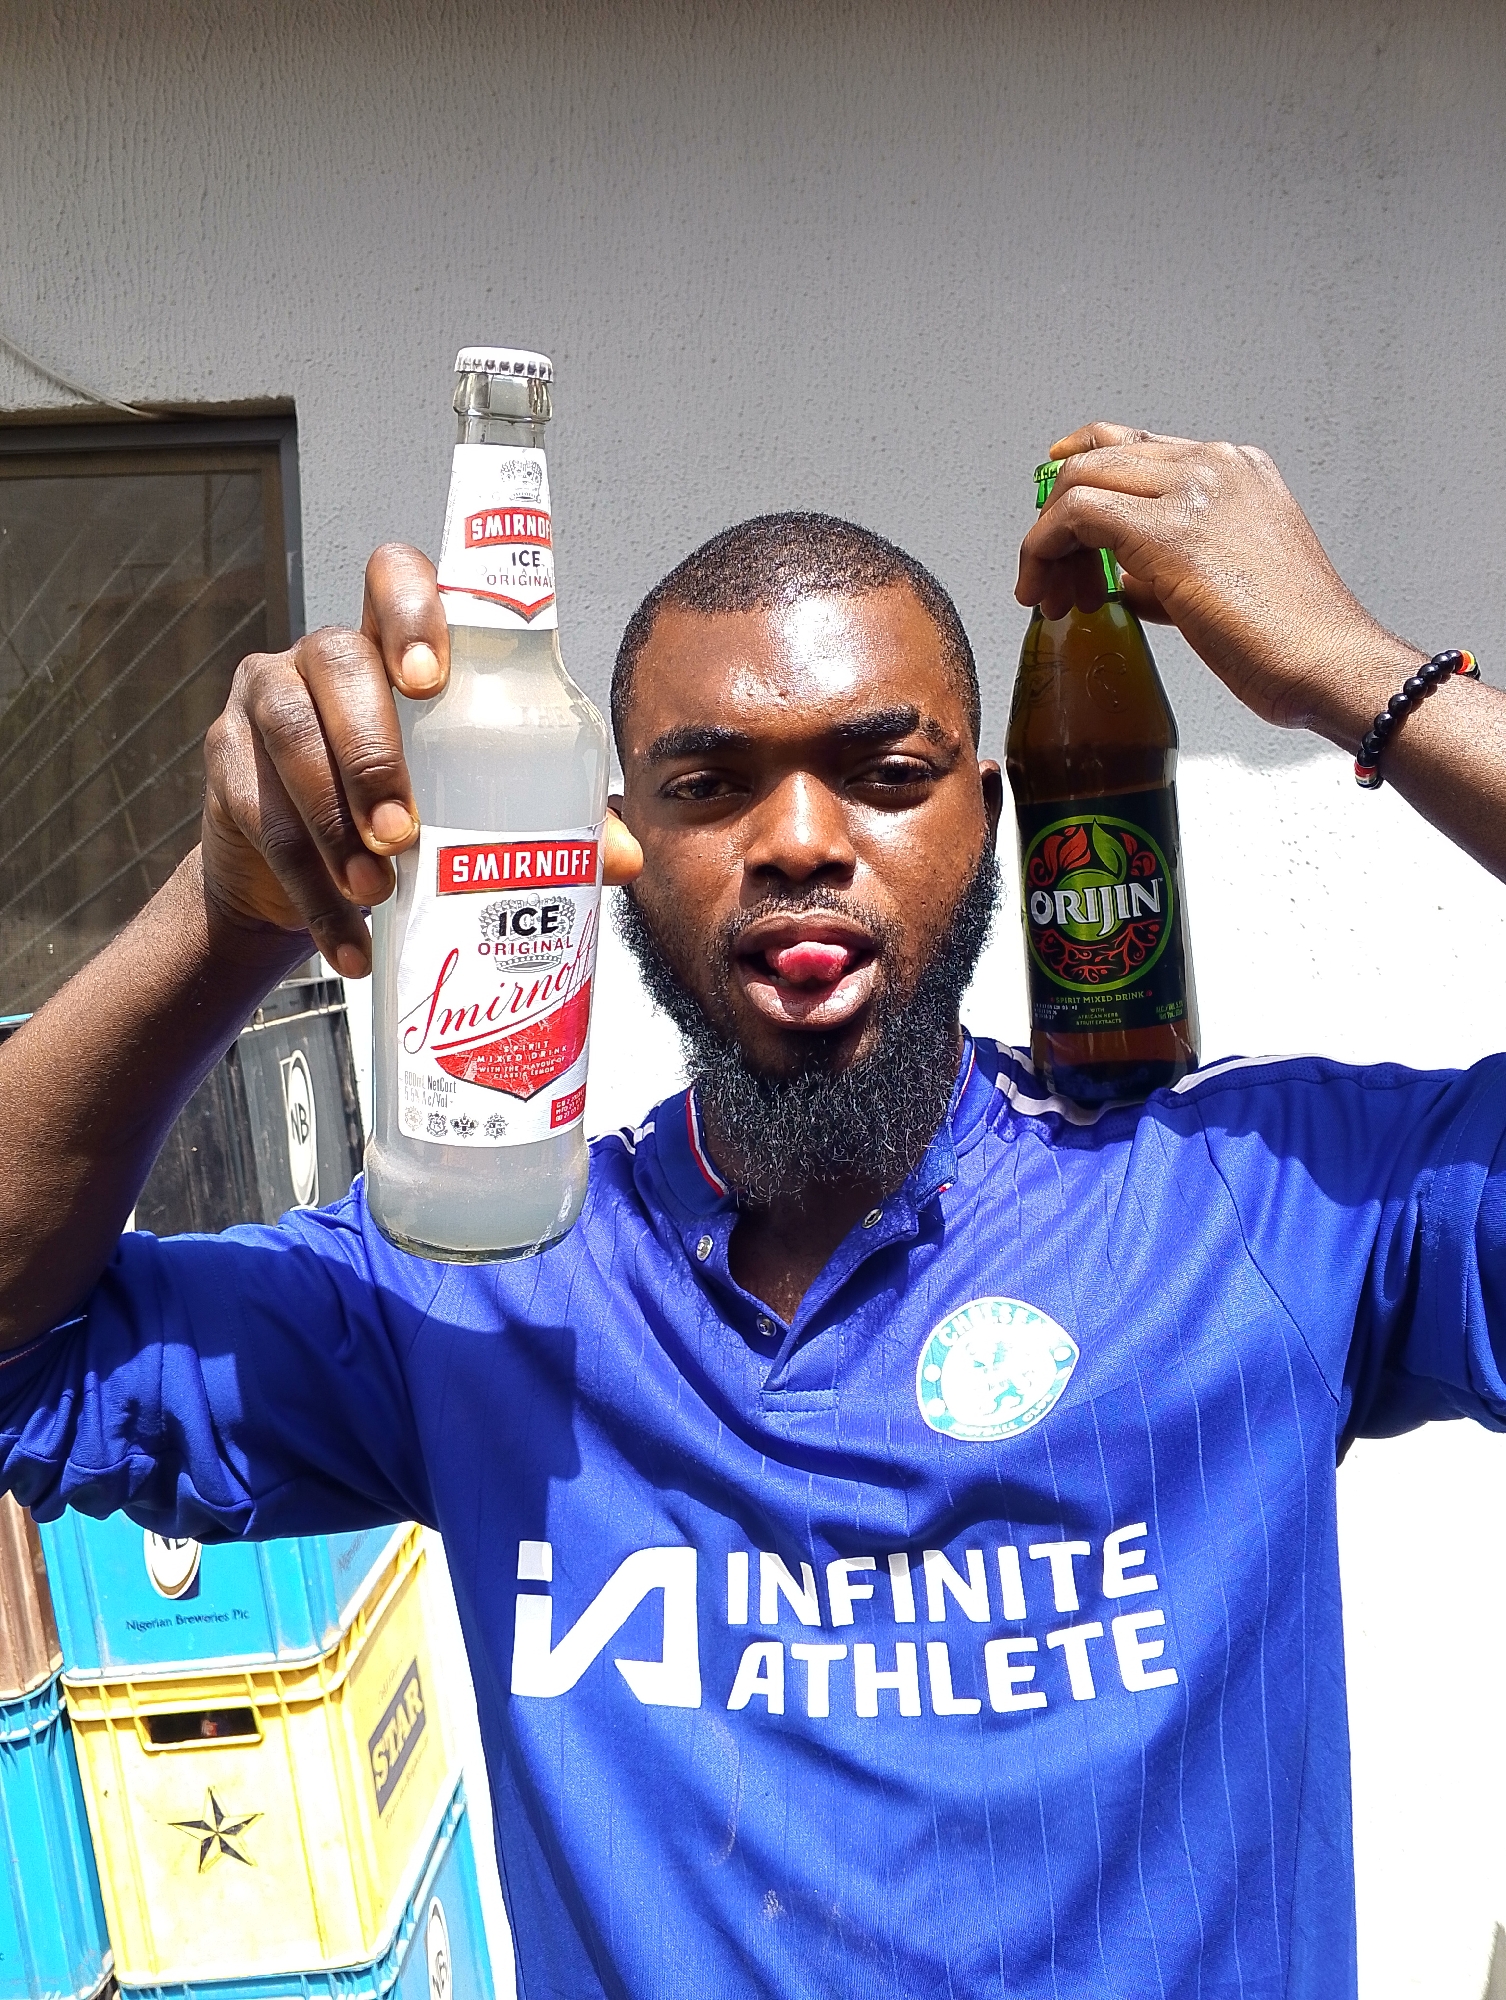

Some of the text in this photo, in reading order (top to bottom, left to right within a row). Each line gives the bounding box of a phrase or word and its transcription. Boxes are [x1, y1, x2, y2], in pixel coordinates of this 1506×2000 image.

[471, 512, 553, 542] SMIRNOF
[511, 550, 541, 568] ICE
[487, 574, 554, 589] ORIGINAL
[451, 848, 592, 883] SMIRNOFF
[498, 904, 561, 937] ICE
[477, 937, 574, 956] ORIGINAL
[399, 904, 600, 1055] Smirnoff
[1056, 990, 1145, 1005] SPIRIT MIXED DRINK
[1078, 1012, 1103, 1020] AFRICAN
[476, 1045, 567, 1063] MIXED DRINK
[503, 1040, 549, 1053] SPIRIT
[479, 1065, 501, 1073] WITH
[504, 1064, 520, 1072] THE
[530, 1065, 555, 1076] LEMON
[290, 1102, 311, 1145] NB
[726, 1522, 1160, 1628] INFINITE
[126, 1617, 173, 1634] Nigerian
[175, 1612, 230, 1626] Breweries
[726, 1610, 1179, 1719] ATHLETE
[371, 1677, 424, 1791] STAR
